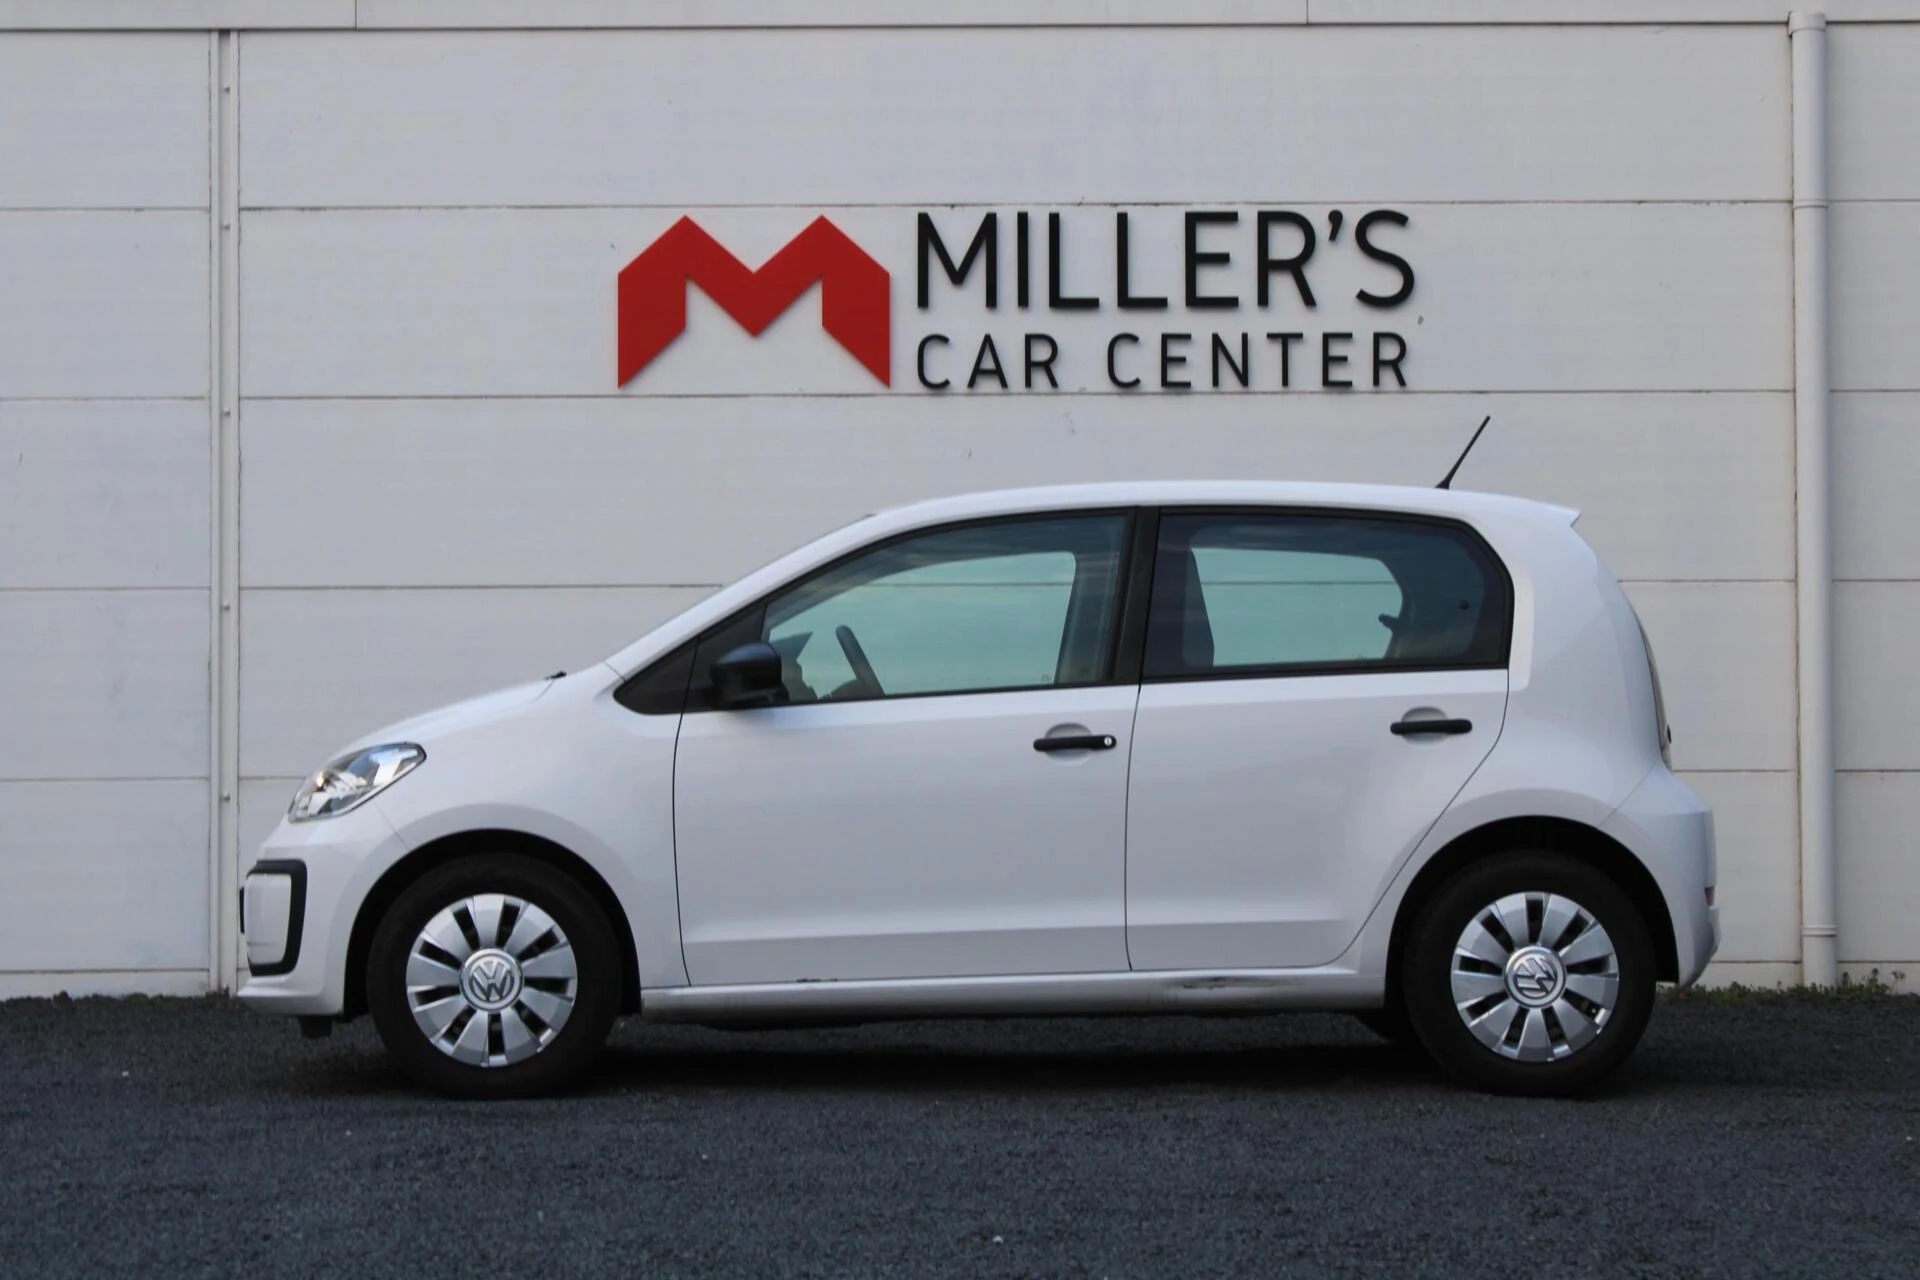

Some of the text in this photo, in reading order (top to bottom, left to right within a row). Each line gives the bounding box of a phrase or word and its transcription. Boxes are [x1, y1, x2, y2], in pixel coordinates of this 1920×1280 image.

[917, 209, 1416, 311] MILLER'S
[917, 332, 1408, 391] CAR CENTER
